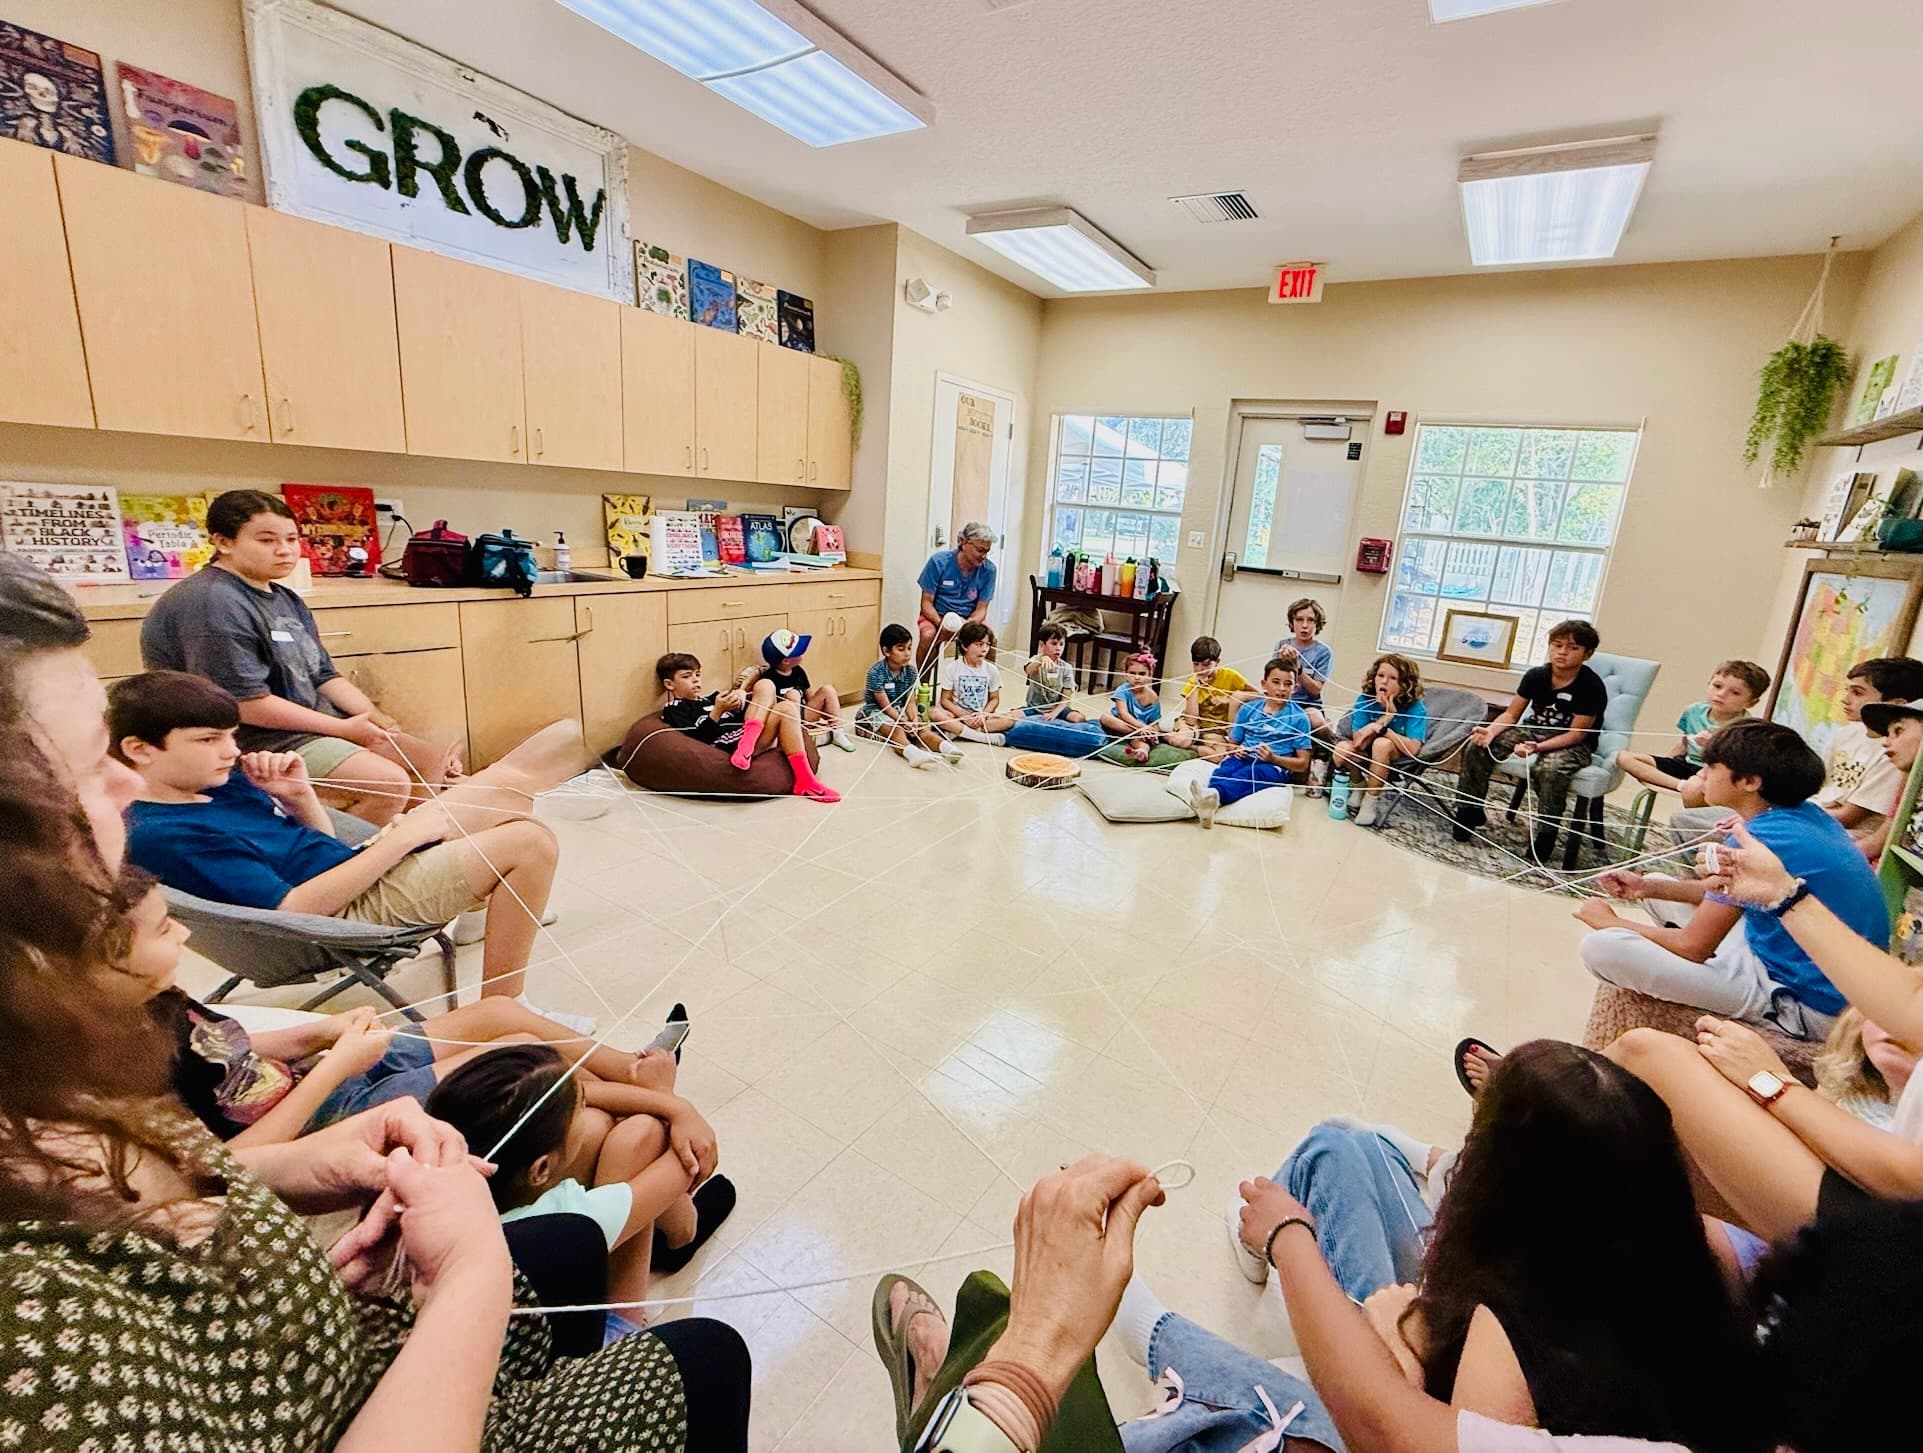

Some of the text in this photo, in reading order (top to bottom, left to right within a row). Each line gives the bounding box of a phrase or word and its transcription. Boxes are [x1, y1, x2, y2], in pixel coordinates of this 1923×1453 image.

[294, 84, 606, 251] GROW
[1279, 269, 1317, 298] EXIT
[18, 508, 105, 519] TIMELINES
[41, 519, 87, 528] FROM
[750, 521, 773, 531] ATLAS
[39, 528, 91, 537] BLACK
[148, 529, 193, 539] Periodic
[32, 537, 100, 546] HISTORY
[159, 540, 187, 548] Table
